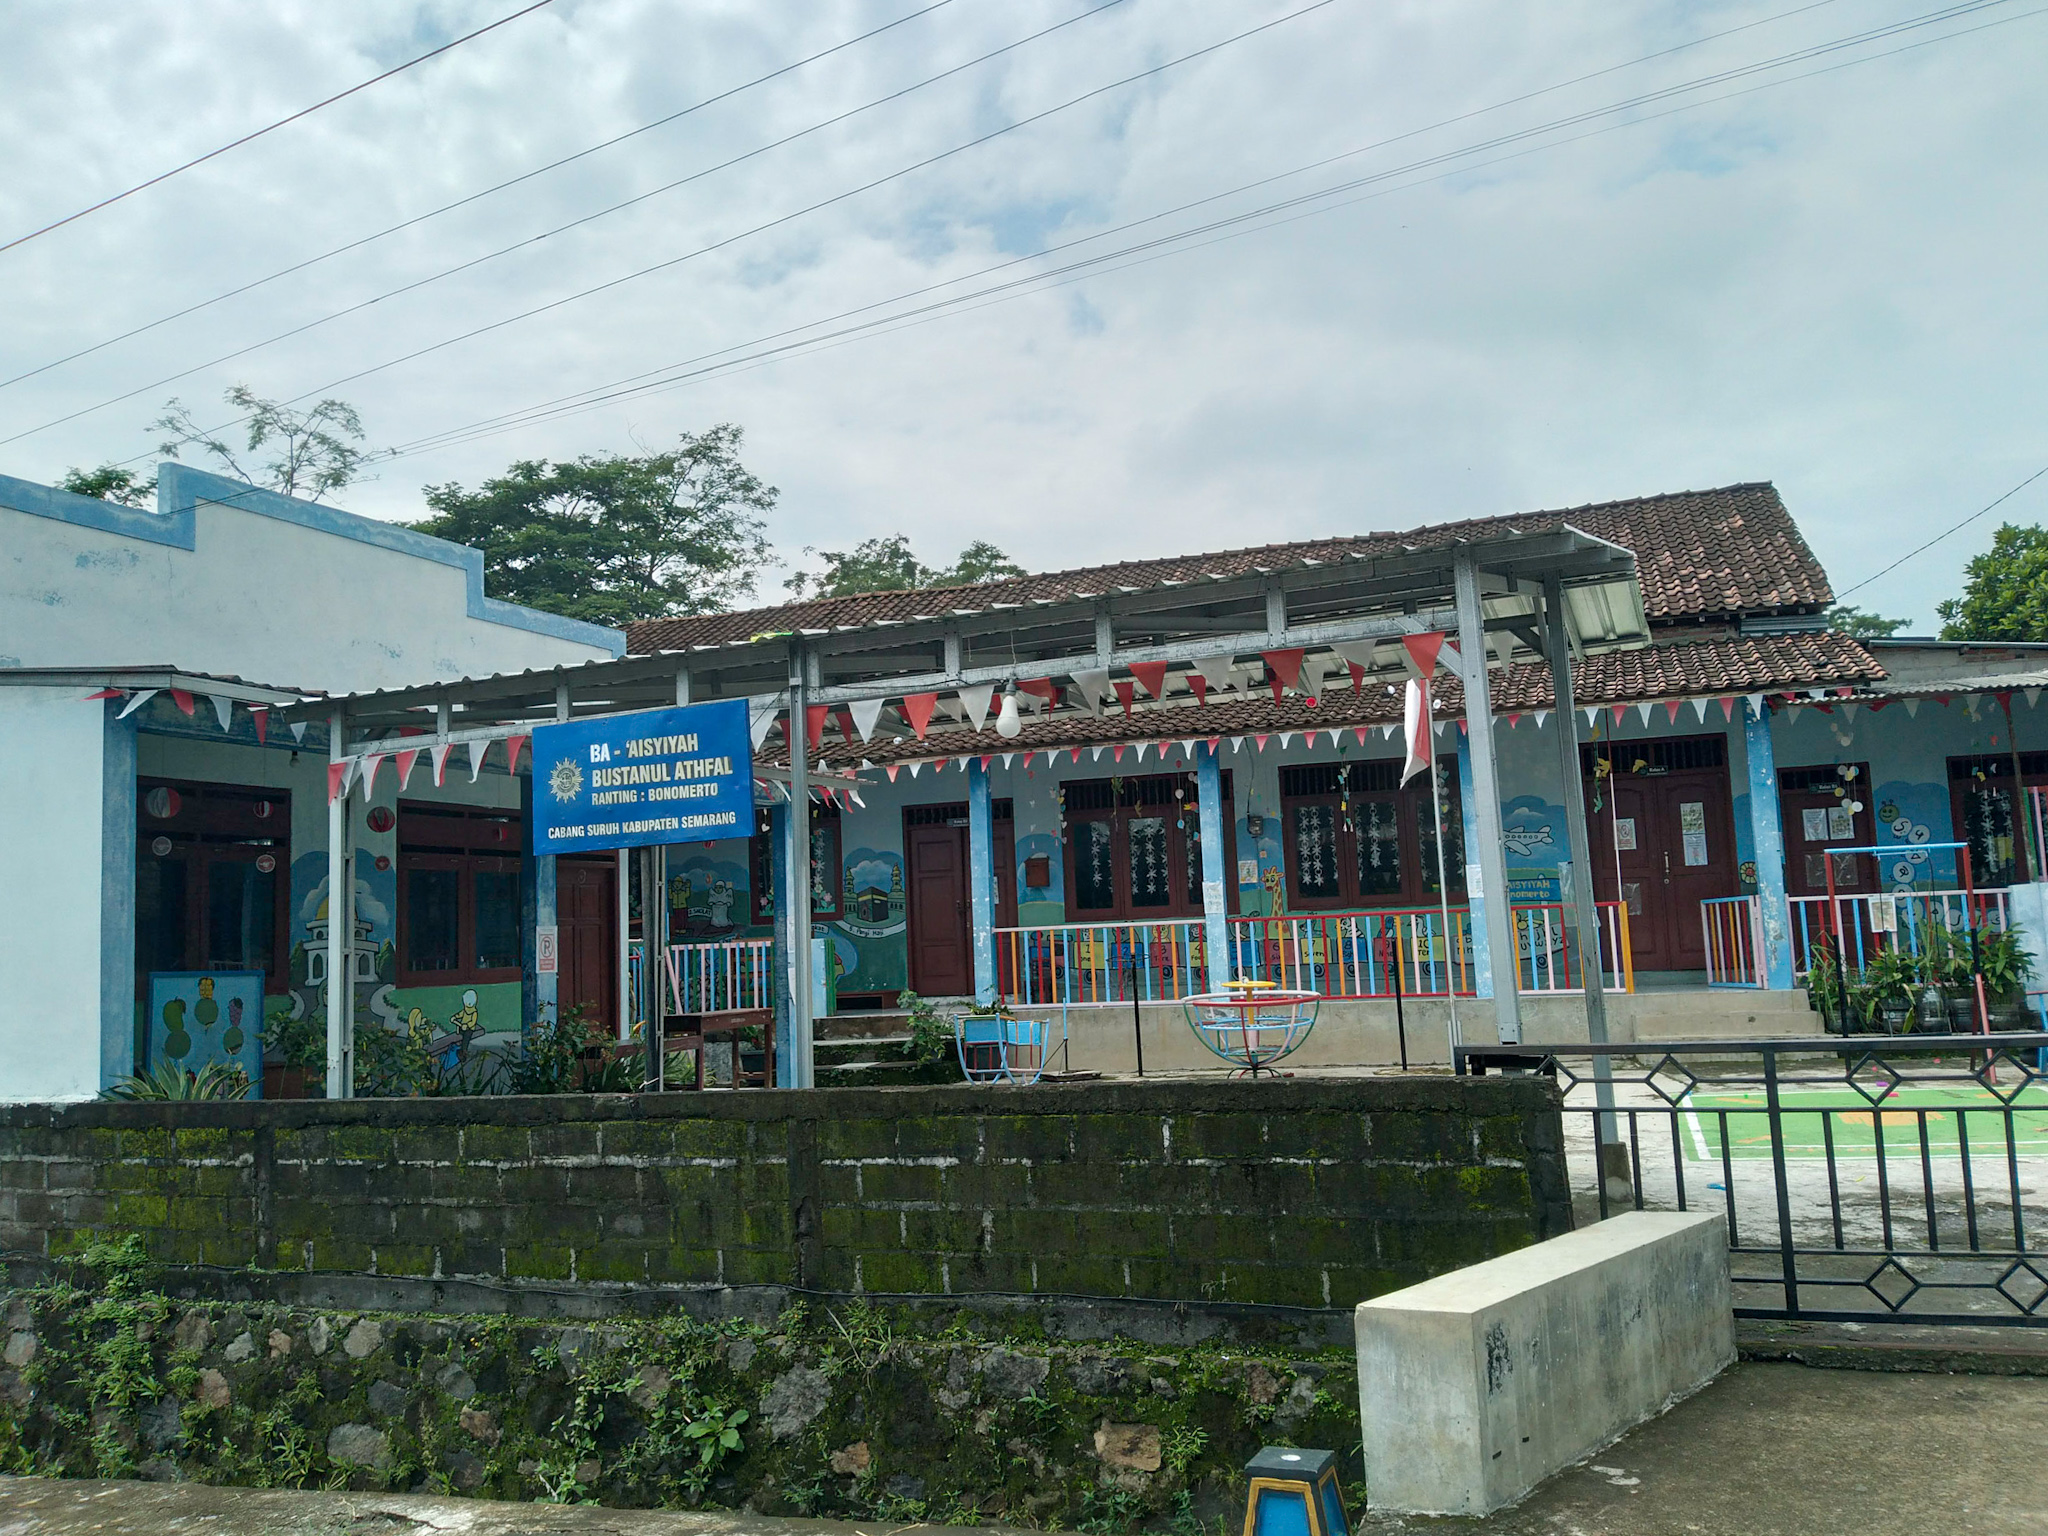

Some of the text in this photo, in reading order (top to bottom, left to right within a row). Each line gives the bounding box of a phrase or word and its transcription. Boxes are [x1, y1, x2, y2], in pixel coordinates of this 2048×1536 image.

[590, 743, 610, 762] BA
[592, 761, 671, 788] BUSTANUL
[674, 755, 734, 781] ATHFAL
[591, 789, 638, 806] RANTING
[648, 782, 719, 802] BONOMERTO
[548, 811, 736, 839] CABANG SURUH KABUPATEN SEMARANG
[1510, 890, 1550, 898] nomerto
